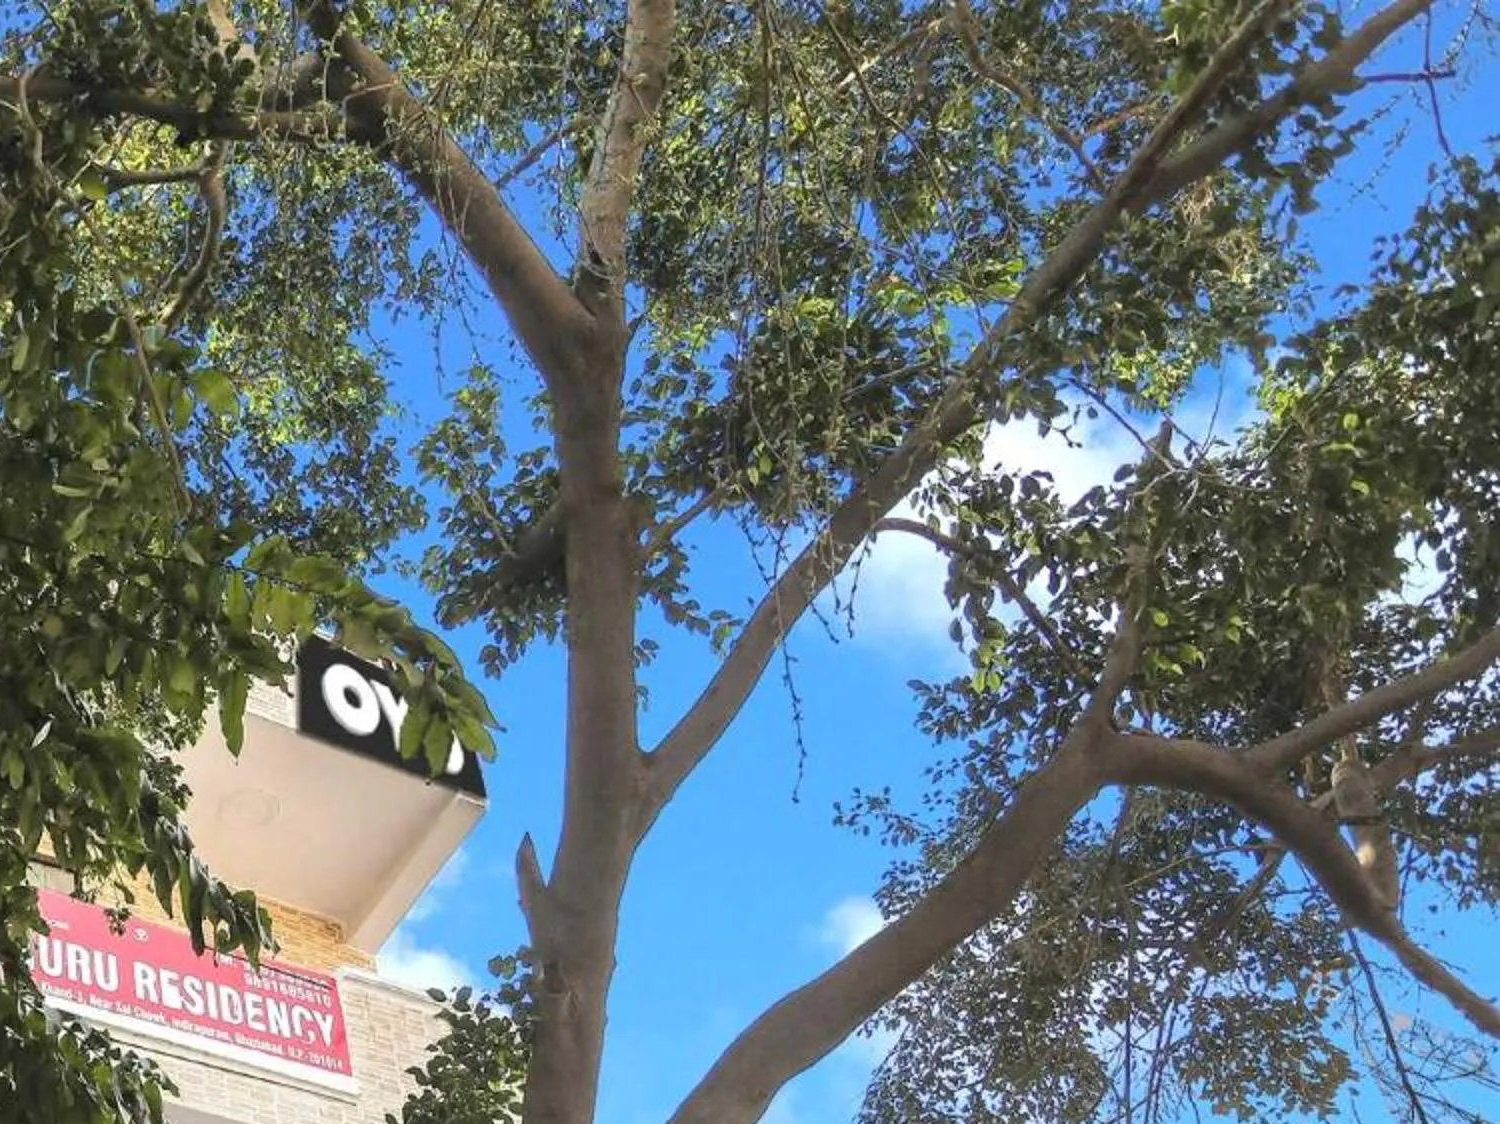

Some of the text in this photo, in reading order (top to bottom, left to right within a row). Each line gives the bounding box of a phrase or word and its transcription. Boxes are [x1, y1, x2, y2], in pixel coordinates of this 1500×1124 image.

[322, 663, 465, 775] OY
[30, 936, 119, 992] URU
[132, 960, 334, 1047] RESIDENCY
